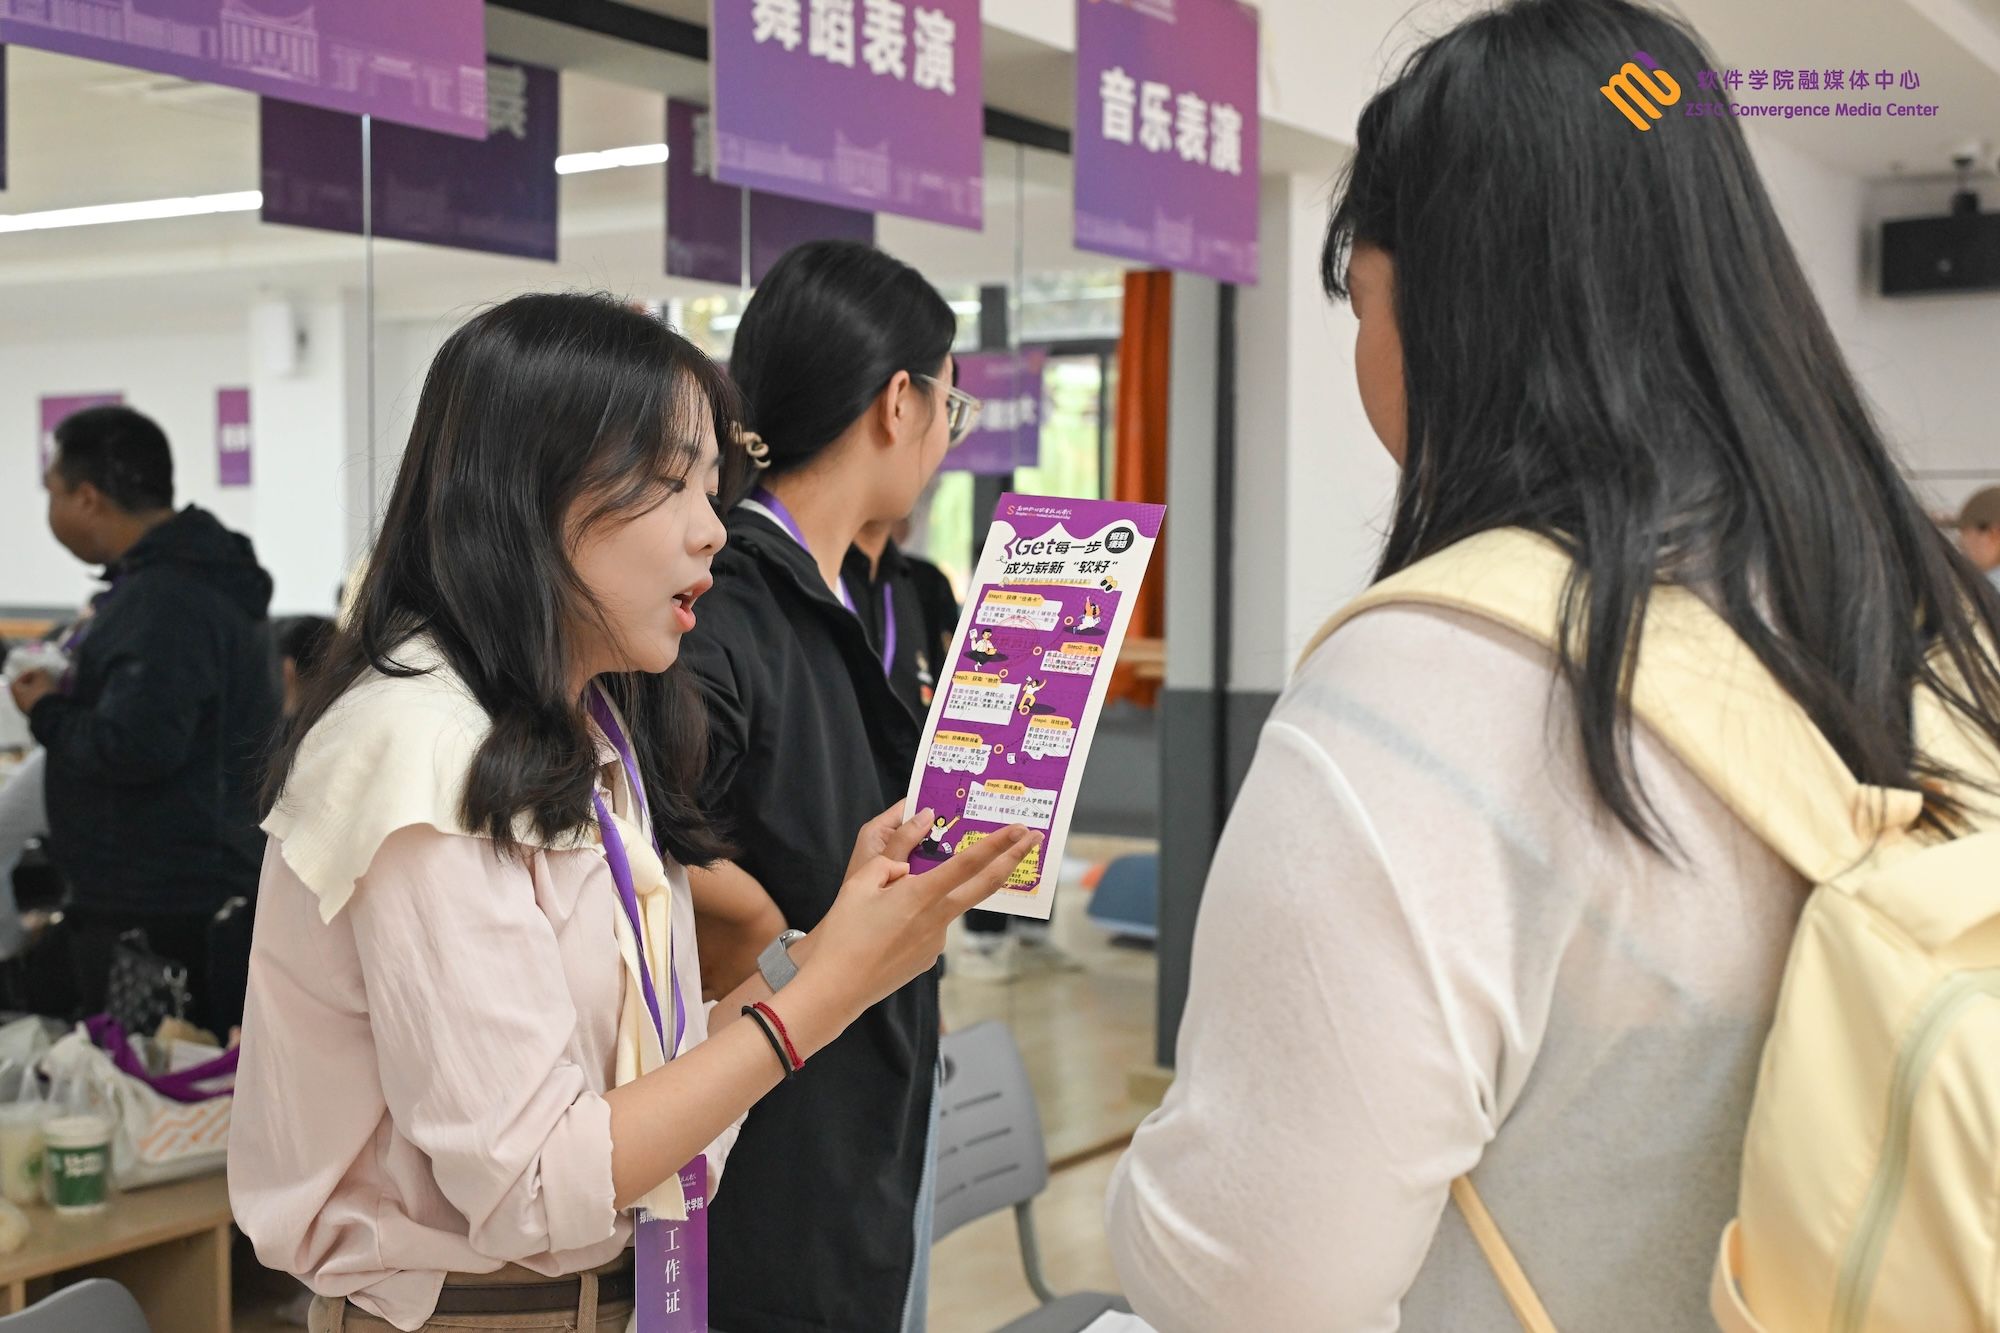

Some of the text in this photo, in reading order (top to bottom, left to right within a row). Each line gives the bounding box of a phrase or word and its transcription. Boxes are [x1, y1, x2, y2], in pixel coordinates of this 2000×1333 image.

[1100, 66, 1243, 176] 音乐表演
[665, 1227, 681, 1314] 工作证
